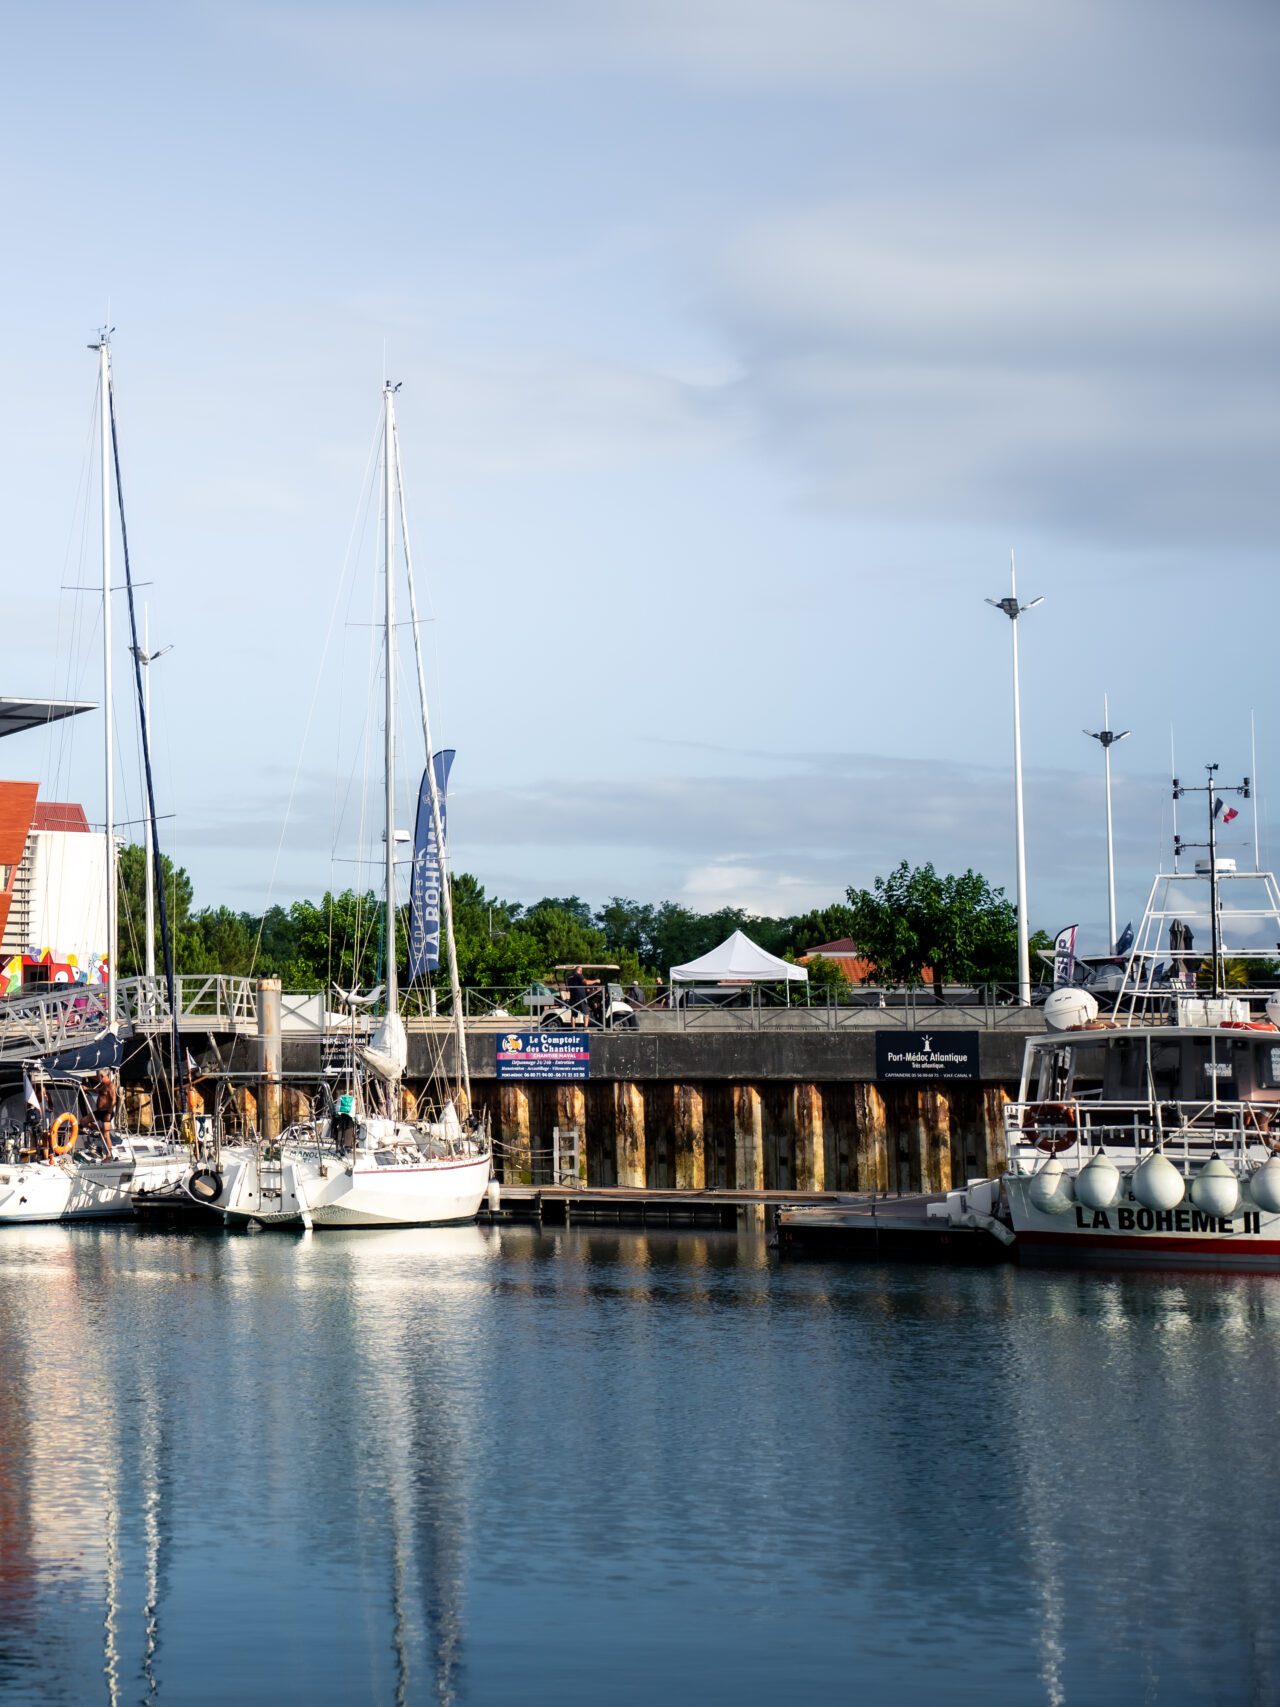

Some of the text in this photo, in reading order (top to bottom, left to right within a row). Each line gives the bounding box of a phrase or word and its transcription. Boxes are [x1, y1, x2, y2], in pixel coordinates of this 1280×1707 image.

[541, 1034, 580, 1045] Comptoir
[542, 1044, 584, 1052] Chantiers
[888, 1052, 968, 1063] Port-Médoc Atlantique
[1076, 1206, 1261, 1234] LA BOHEME II
